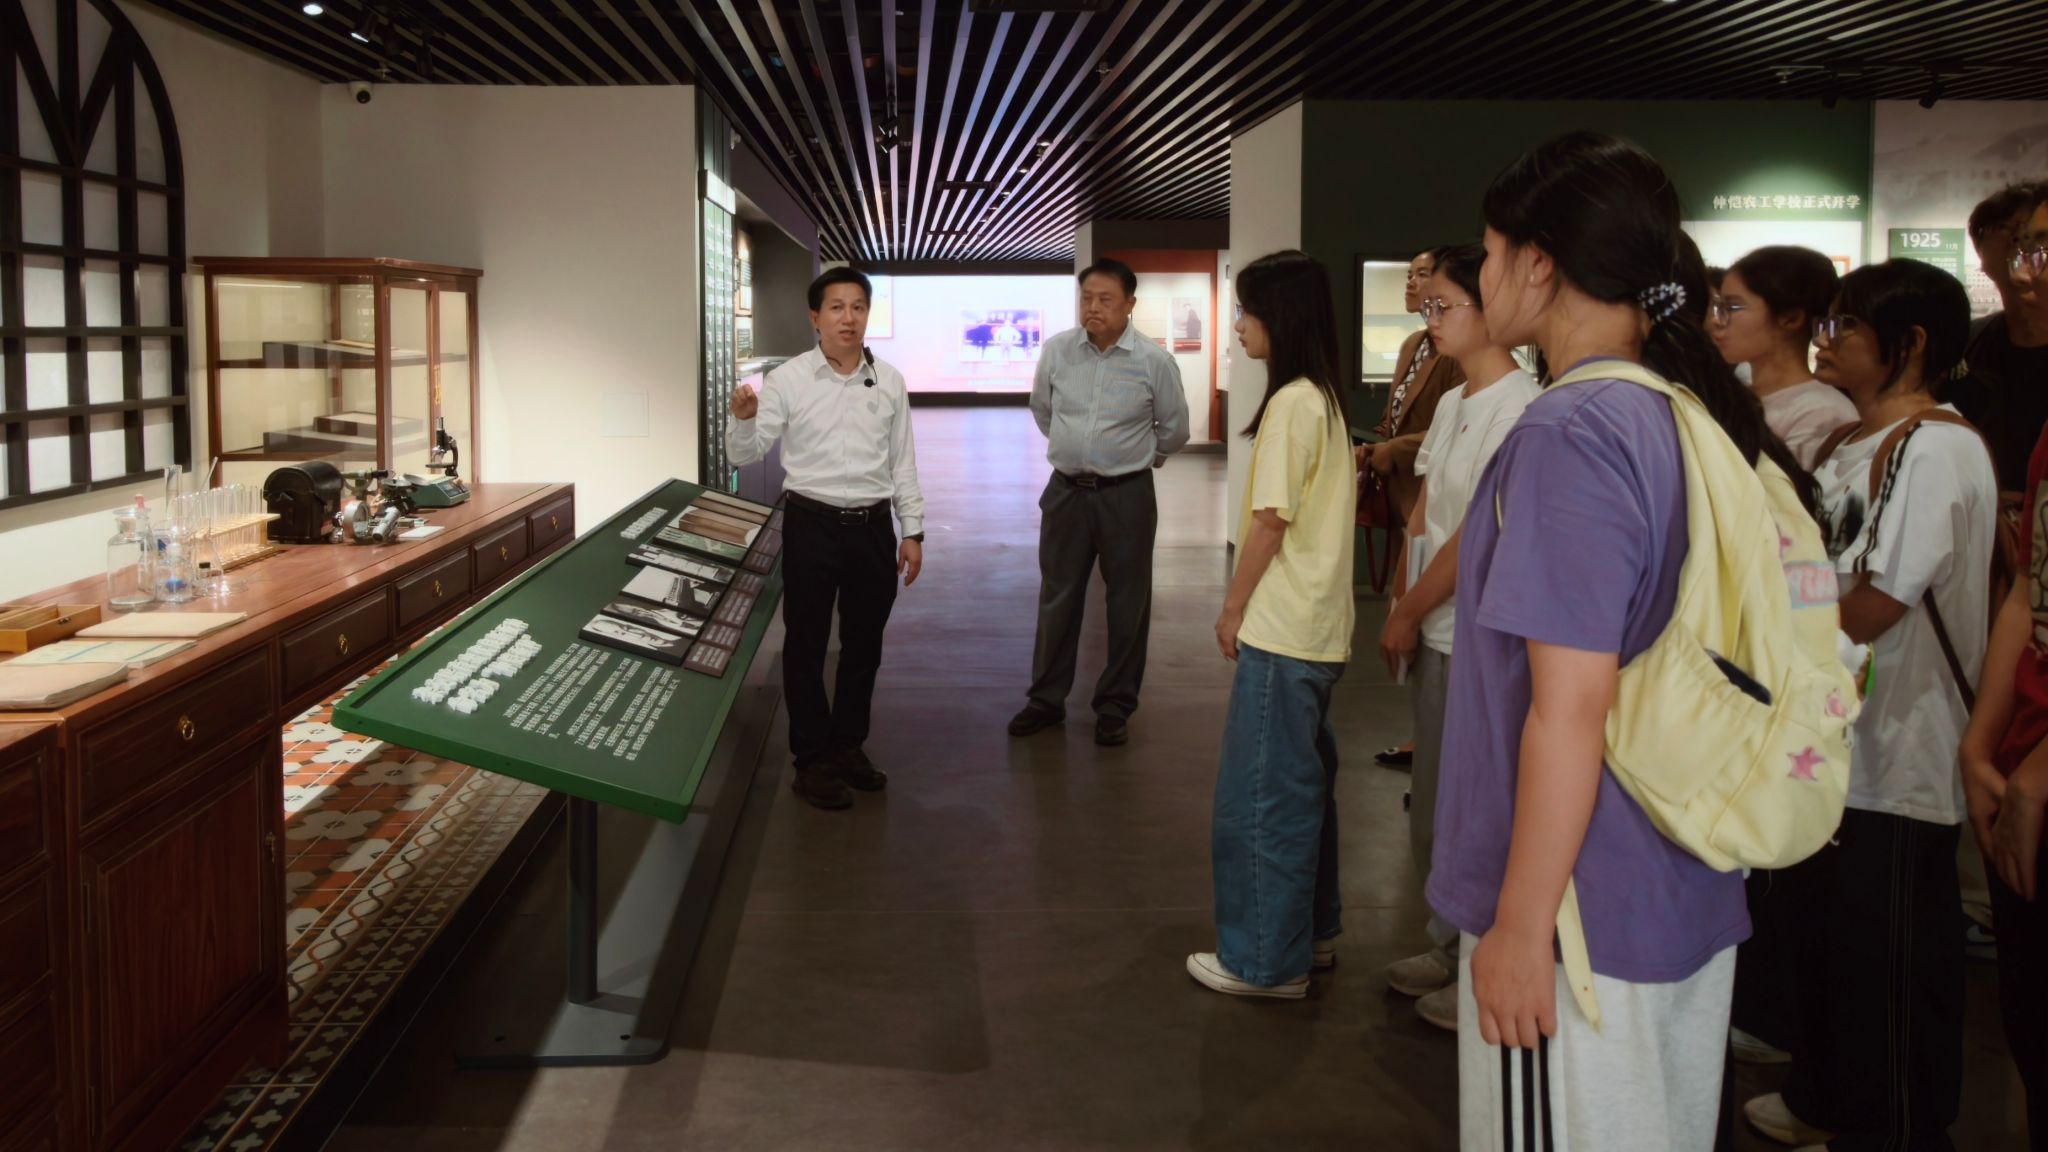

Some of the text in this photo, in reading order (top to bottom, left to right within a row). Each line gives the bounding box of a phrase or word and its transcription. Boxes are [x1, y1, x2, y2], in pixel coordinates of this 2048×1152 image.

[1713, 194, 1861, 210] 仲恺农工学校正式开学
[1900, 232, 1941, 248] 1925
